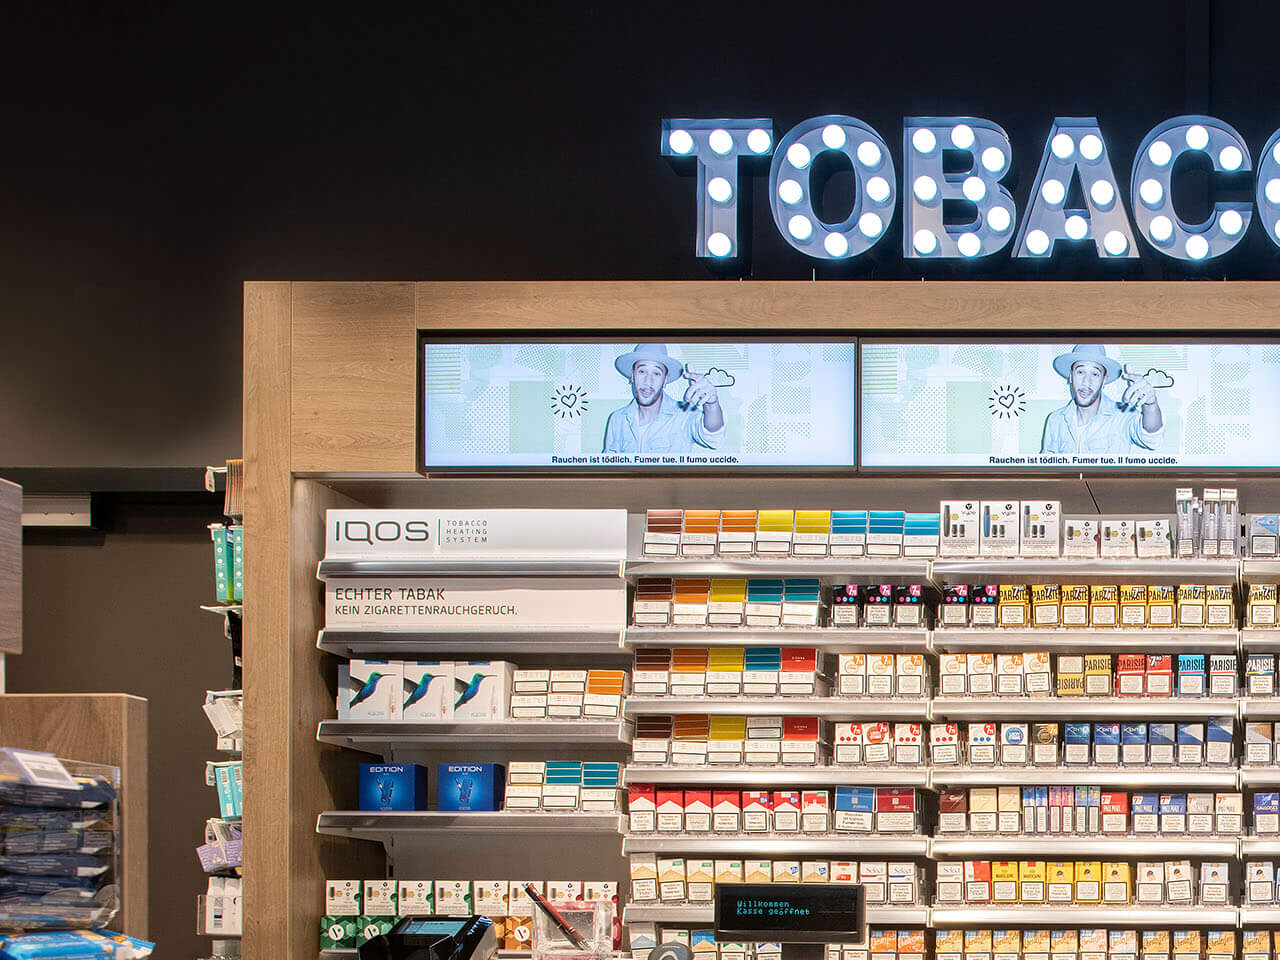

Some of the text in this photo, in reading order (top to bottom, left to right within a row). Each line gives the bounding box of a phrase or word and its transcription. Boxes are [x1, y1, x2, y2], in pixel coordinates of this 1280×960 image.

[552, 455, 739, 465] Rauchen ist tödlich. Fumer tue. Il fumo uccide.
[989, 456, 1179, 466] Rauchen ist tödlich. Fumer tue. Il fumo uccide.
[335, 521, 429, 545] IQOS
[335, 588, 445, 600] ECHTER TABAK
[335, 605, 518, 616] KEIN ZIGARETTENRAUCHGERUCH.
[737, 900, 789, 908] Willkommen
[768, 908, 810, 916] geöffnet
